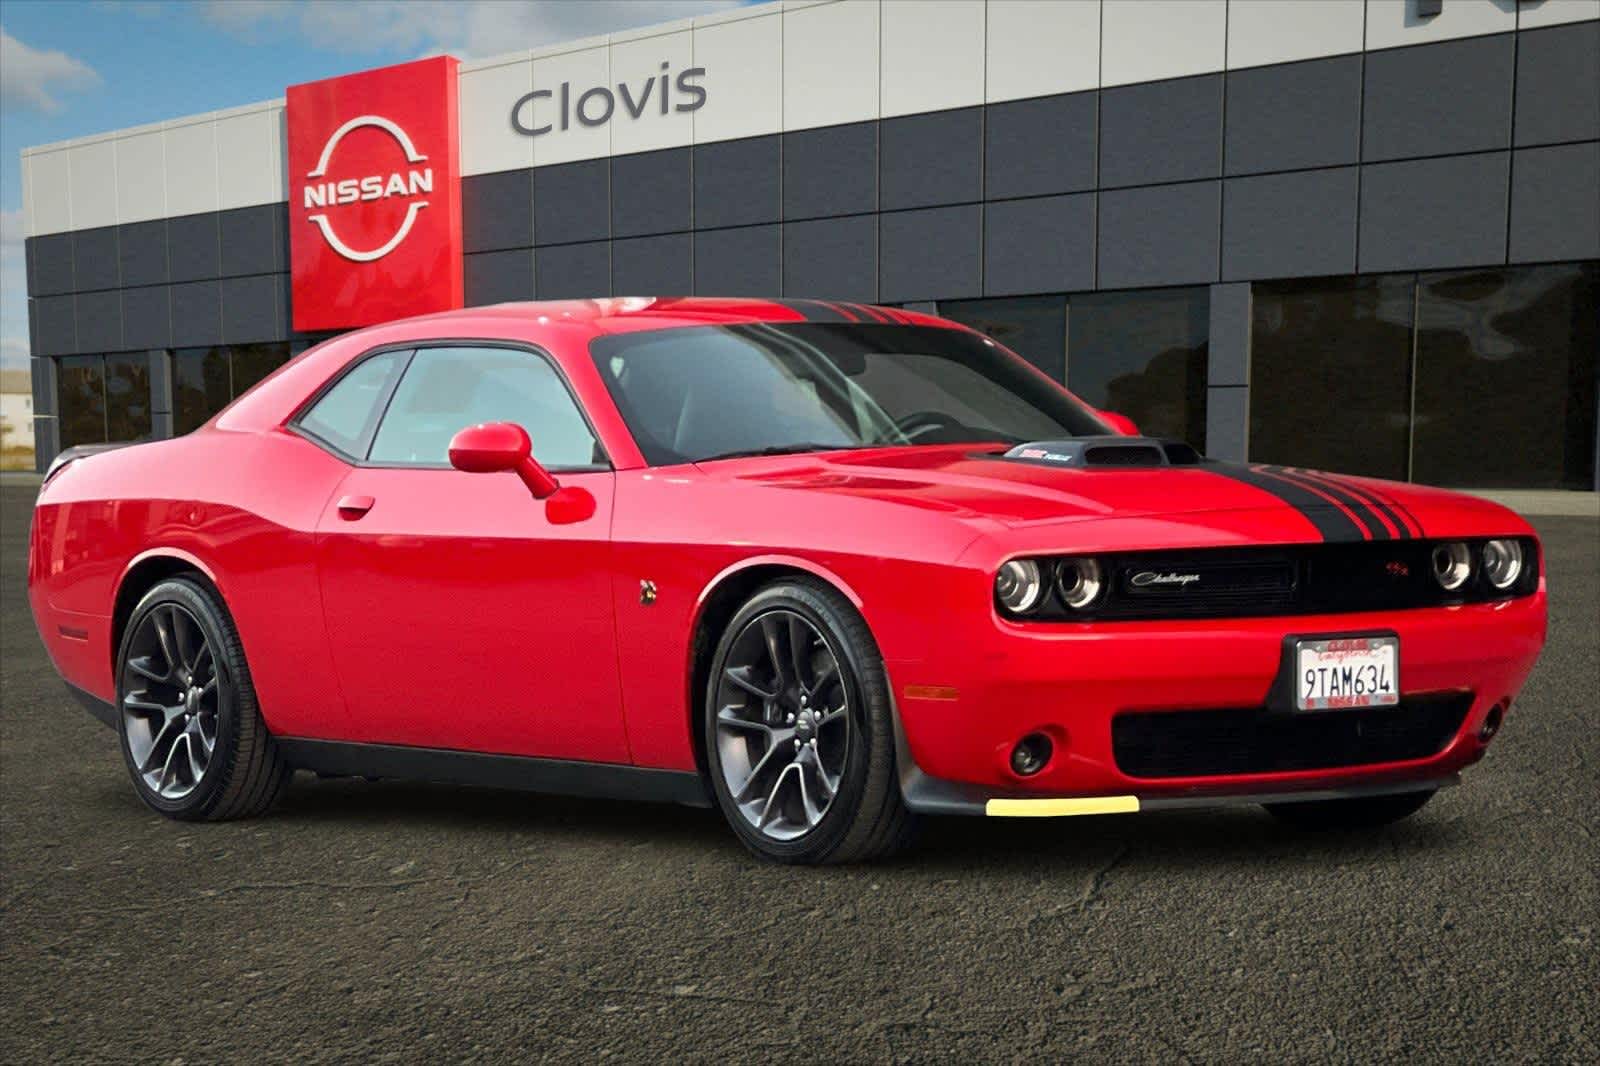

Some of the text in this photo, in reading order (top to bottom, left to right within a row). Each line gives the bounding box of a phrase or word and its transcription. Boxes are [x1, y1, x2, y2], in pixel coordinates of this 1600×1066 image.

[511, 61, 707, 136] Clovis
[304, 168, 433, 208] NISSAN
[1305, 664, 1390, 699] 9TAM634
